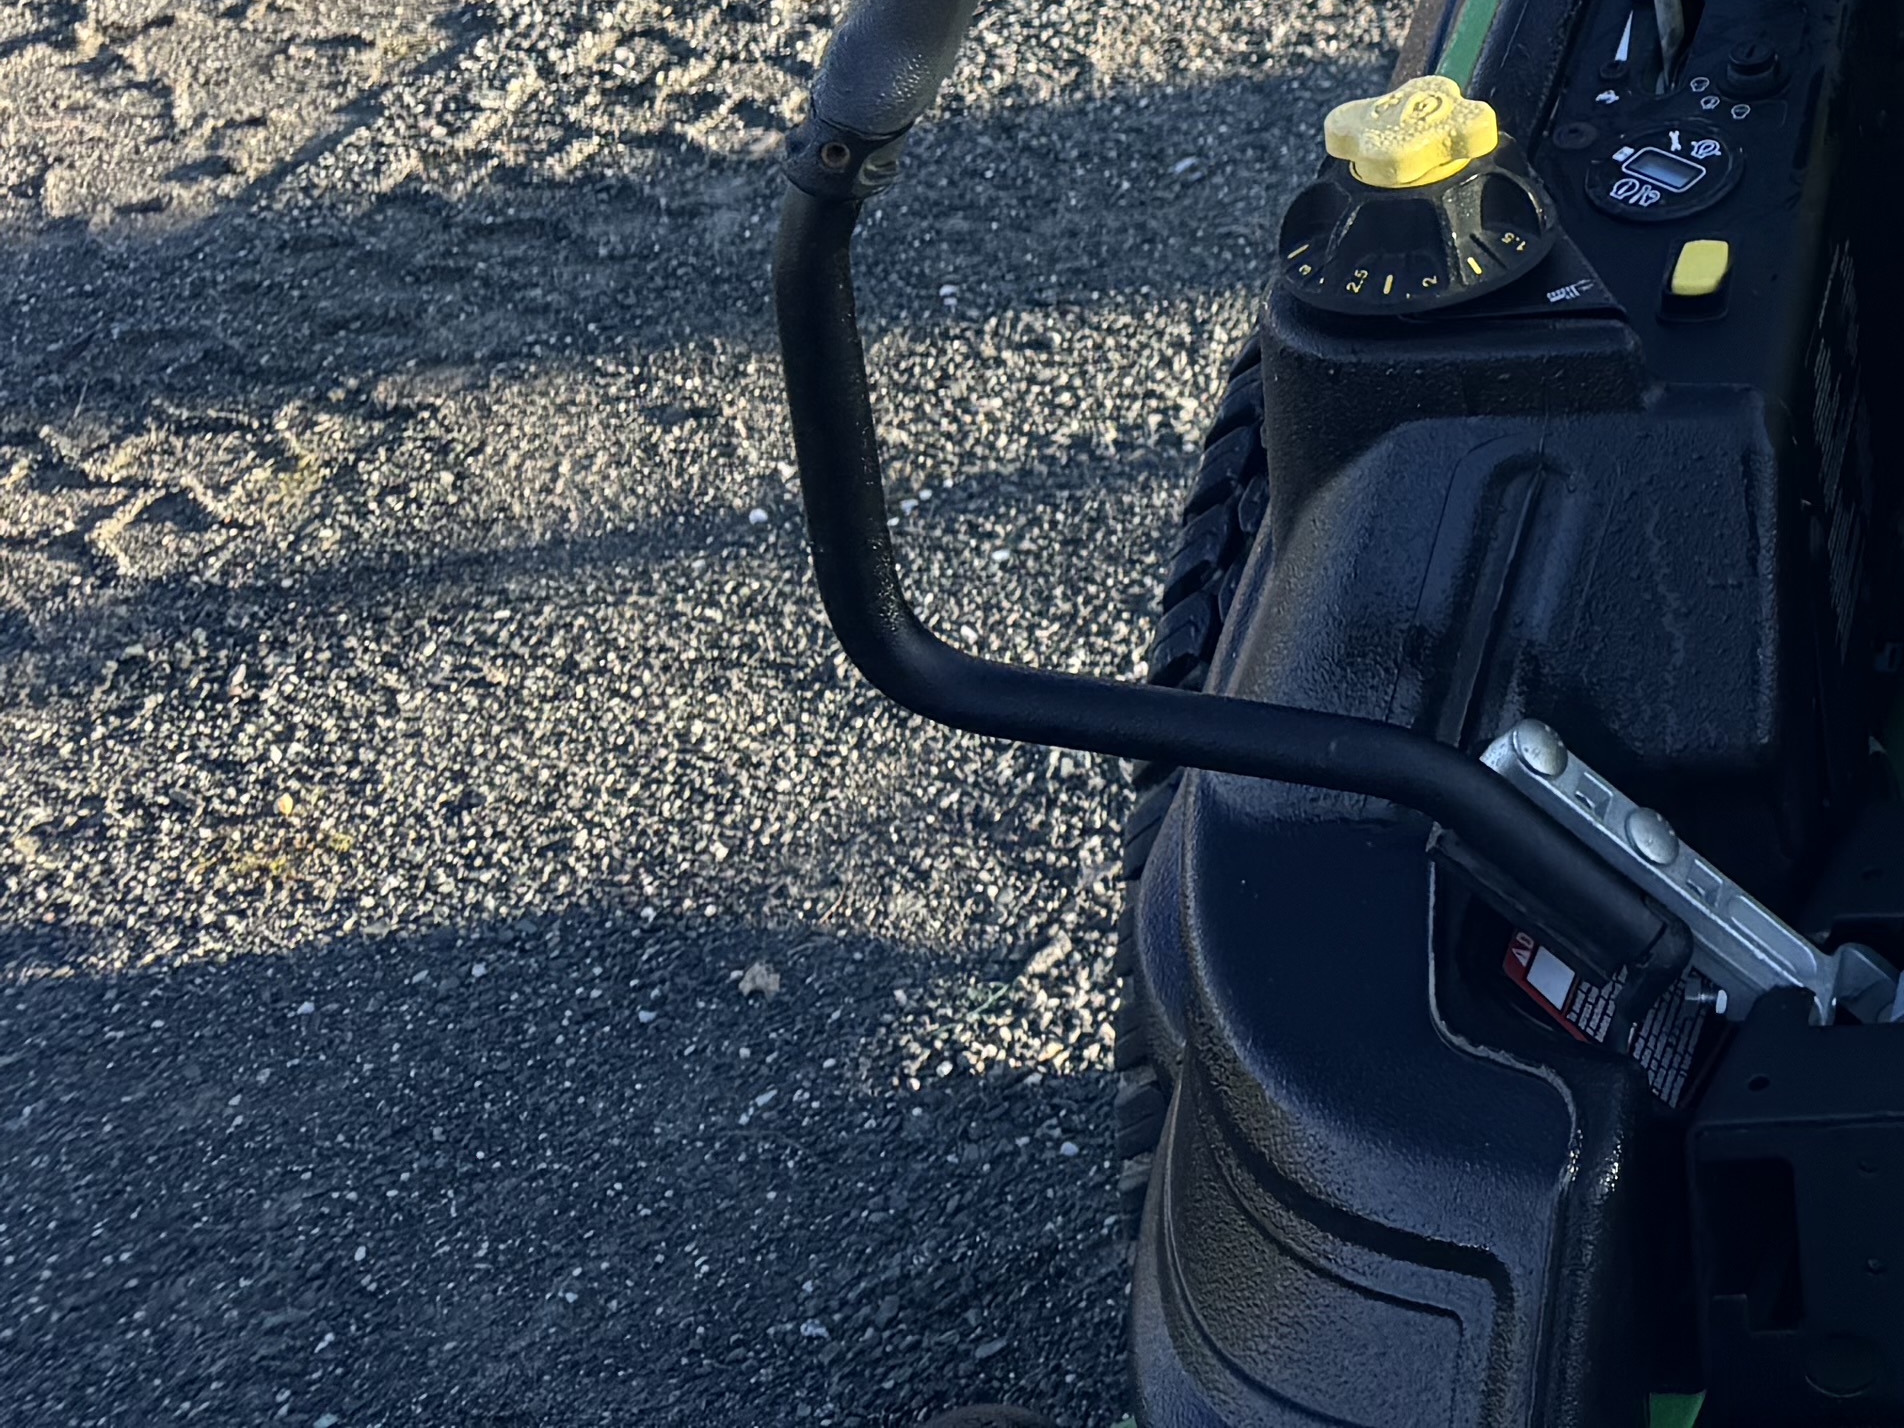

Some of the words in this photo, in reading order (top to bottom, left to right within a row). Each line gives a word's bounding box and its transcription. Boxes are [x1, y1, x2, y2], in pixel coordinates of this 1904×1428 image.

[1501, 231, 1528, 252] 1.5
[1298, 263, 1312, 277] 3
[1345, 268, 1369, 295] 2.5
[1422, 274, 1439, 288] 2
